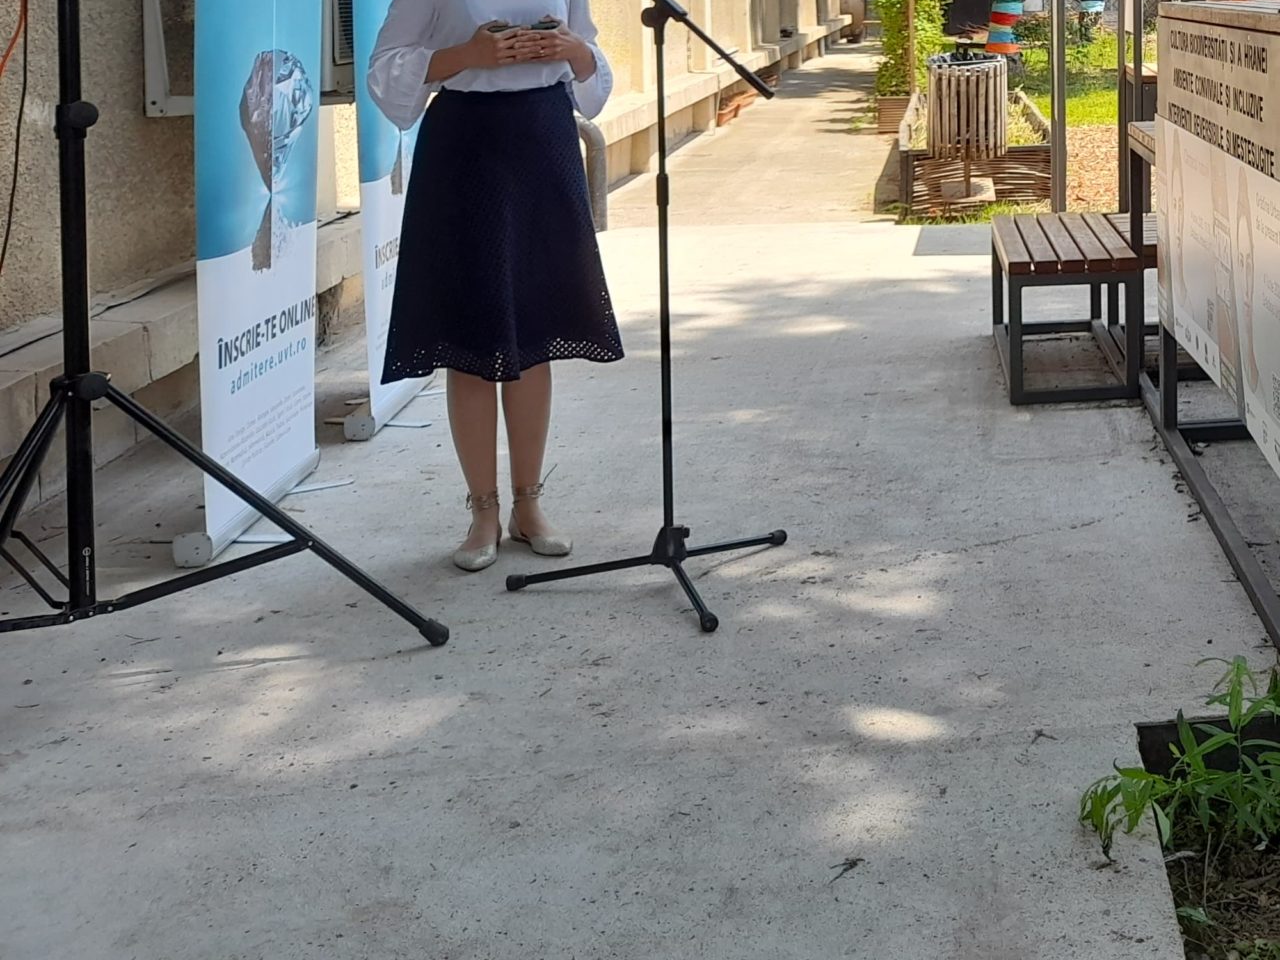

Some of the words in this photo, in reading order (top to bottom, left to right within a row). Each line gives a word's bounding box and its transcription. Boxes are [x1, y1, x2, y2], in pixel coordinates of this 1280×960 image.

[1170, 30, 1188, 52] CULTURA
[1237, 43, 1242, 66] A
[1244, 44, 1268, 74] HRANEI
[1174, 67, 1194, 93] AMBIENTE
[1196, 75, 1223, 106] CONVIVIALE
[1233, 86, 1264, 122] INCLUZIVE
[218, 315, 276, 370] ÎNSCRIE-TE
[279, 296, 316, 334] ONLINE
[230, 336, 307, 394] admitere.uvt.ro
